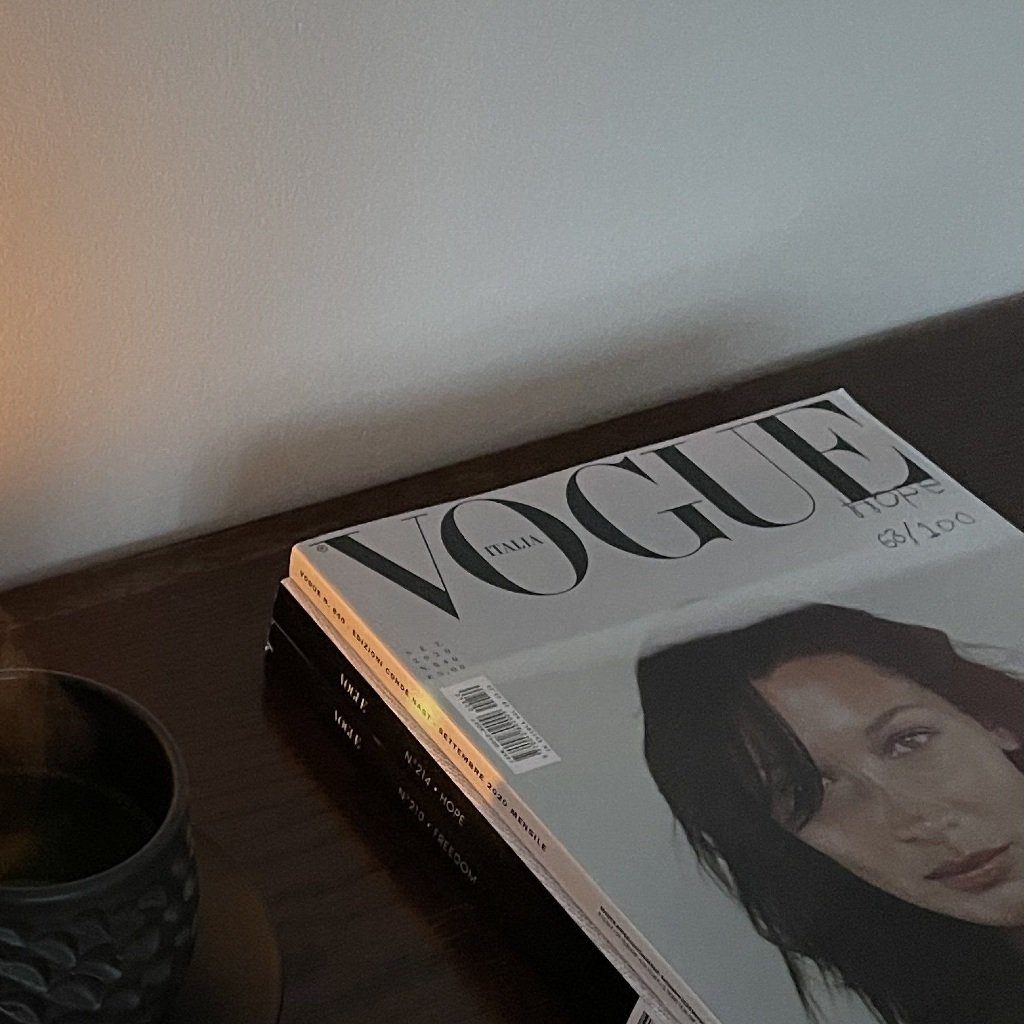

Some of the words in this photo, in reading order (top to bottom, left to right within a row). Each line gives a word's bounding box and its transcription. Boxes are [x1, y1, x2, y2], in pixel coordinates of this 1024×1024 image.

[309, 400, 935, 621] VOGUE
[483, 533, 545, 558] ITALIA
[352, 629, 383, 667] EDIZIONI
[438, 727, 485, 782] SETTEMBRE
[486, 782, 508, 808] 2020
[510, 808, 547, 853] MENSILE
[439, 792, 466, 827] HOPE
